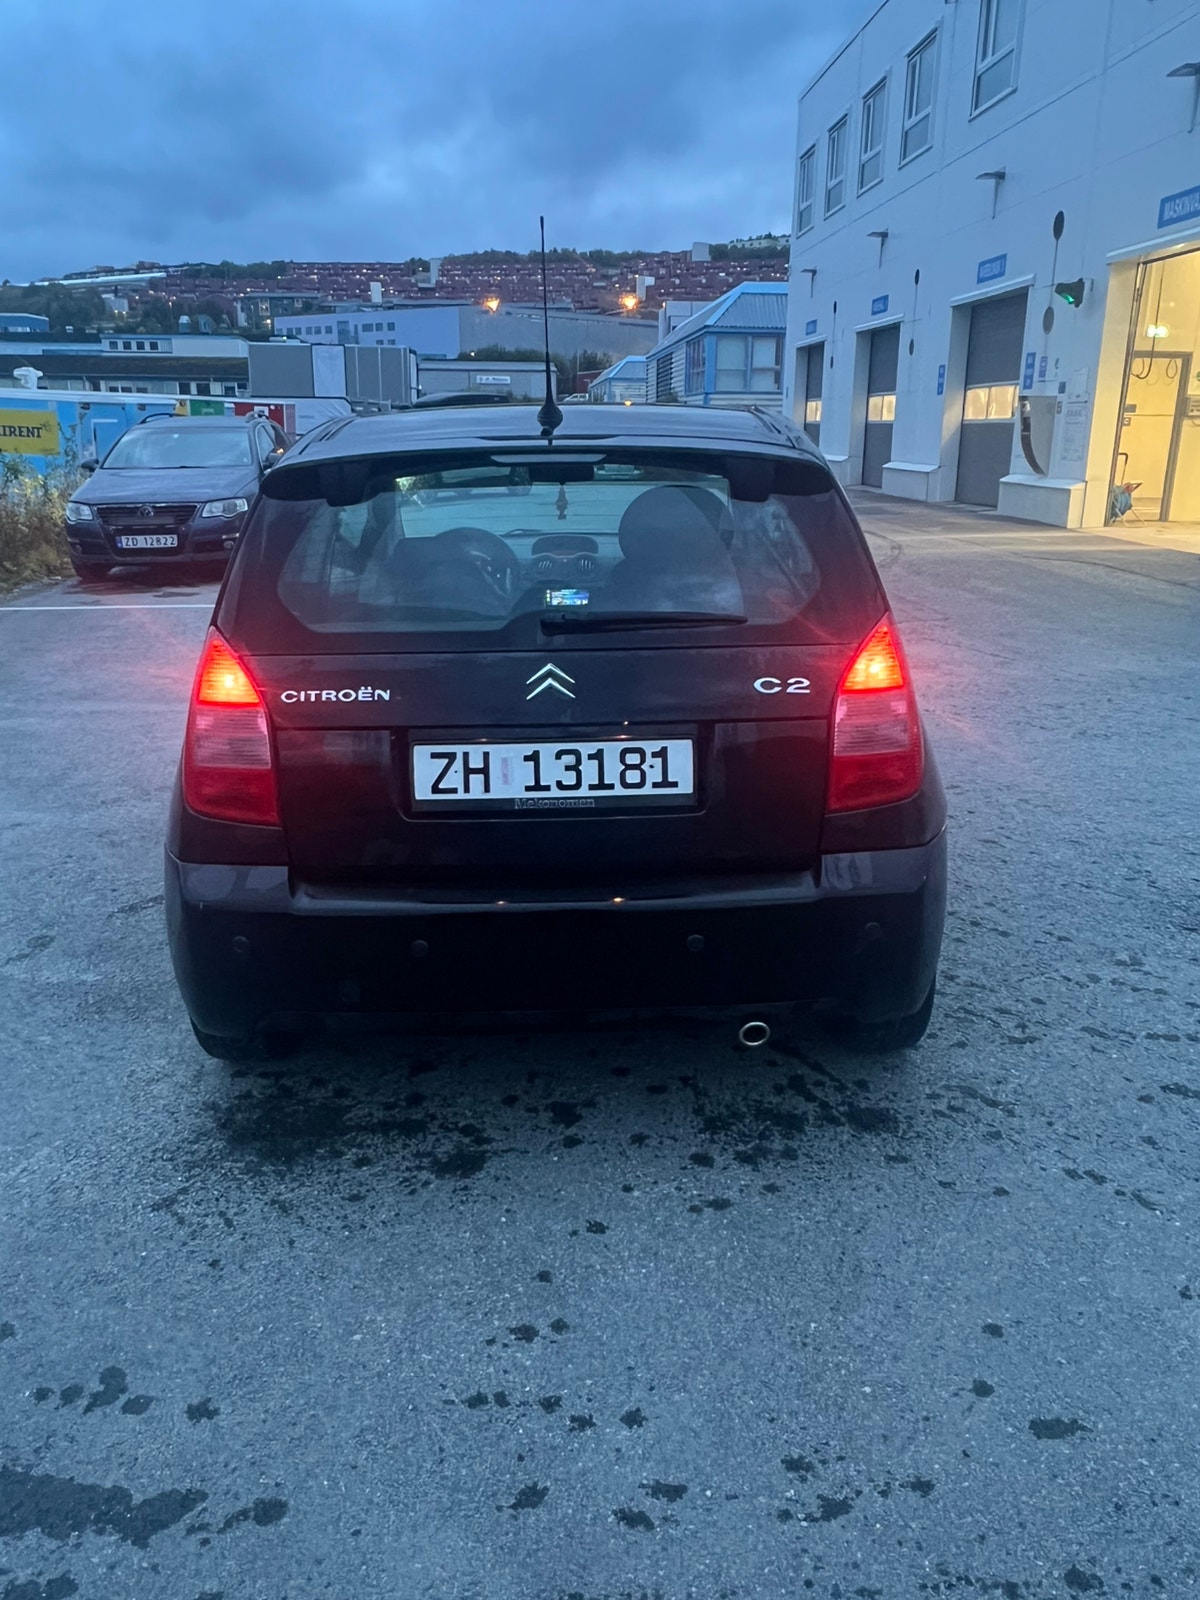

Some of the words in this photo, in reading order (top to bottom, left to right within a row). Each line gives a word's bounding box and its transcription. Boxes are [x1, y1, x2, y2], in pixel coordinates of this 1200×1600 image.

[0, 424, 43, 438] IRENT
[124, 537, 139, 547] ZD
[143, 536, 176, 547] 12822
[753, 677, 811, 694] C2
[280, 686, 391, 703] CITROËN
[430, 751, 491, 795] ZH
[523, 746, 679, 792] 13181
[514, 798, 596, 809] Mekonomen
